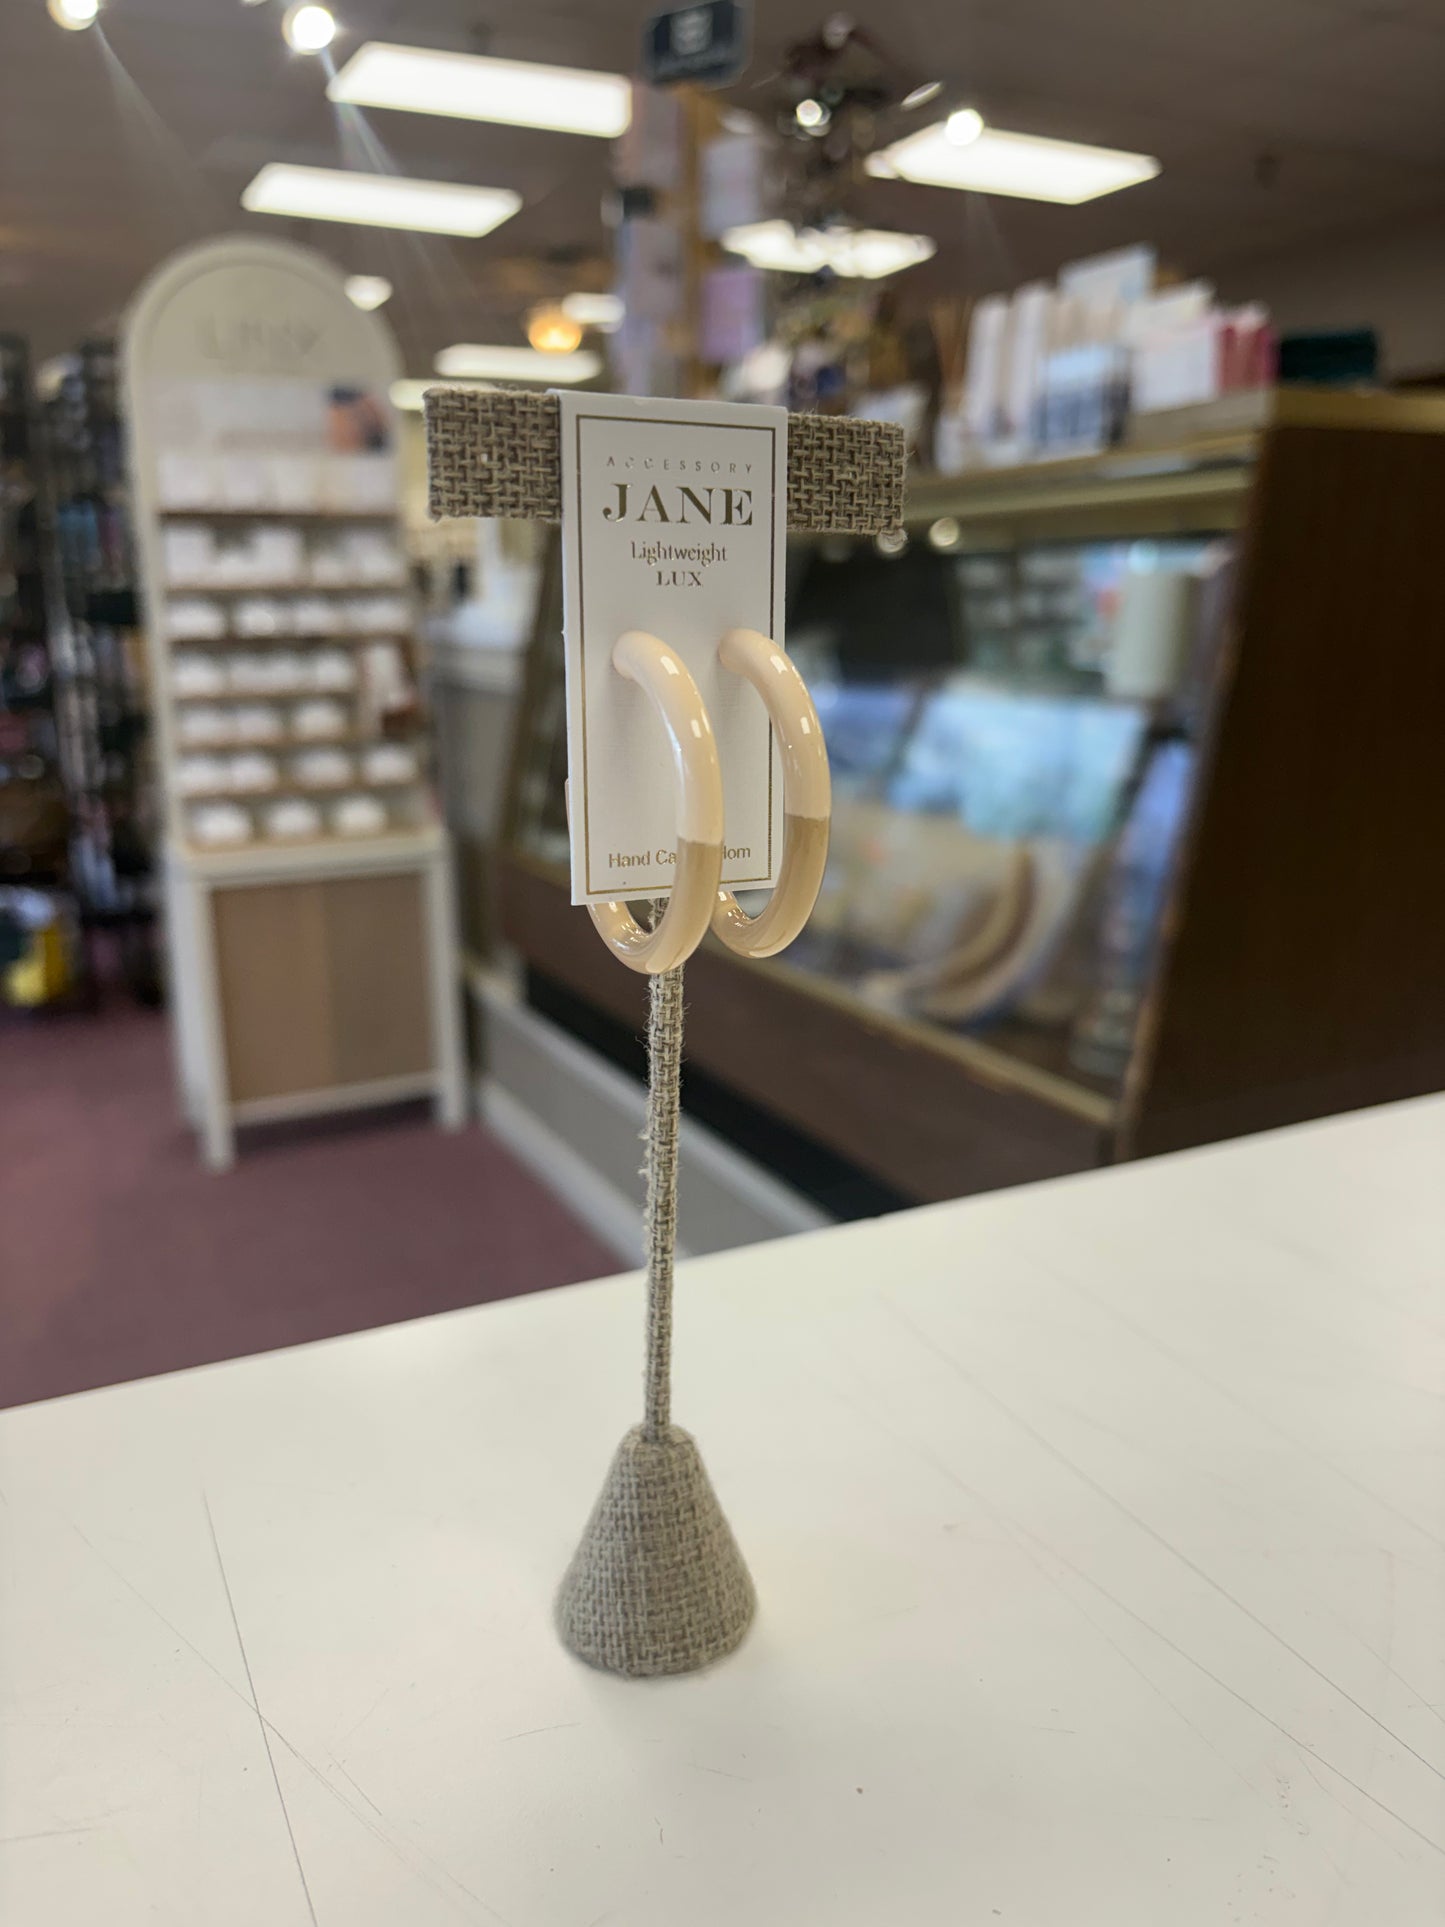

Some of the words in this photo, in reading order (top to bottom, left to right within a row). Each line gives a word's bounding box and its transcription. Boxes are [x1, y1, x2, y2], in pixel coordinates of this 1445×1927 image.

[606, 455, 753, 474] ACCESSORY
[602, 483, 753, 526] JANE
[631, 541, 728, 567] Lightweight
[655, 570, 703, 587] LUX
[608, 850, 650, 868] Hand
